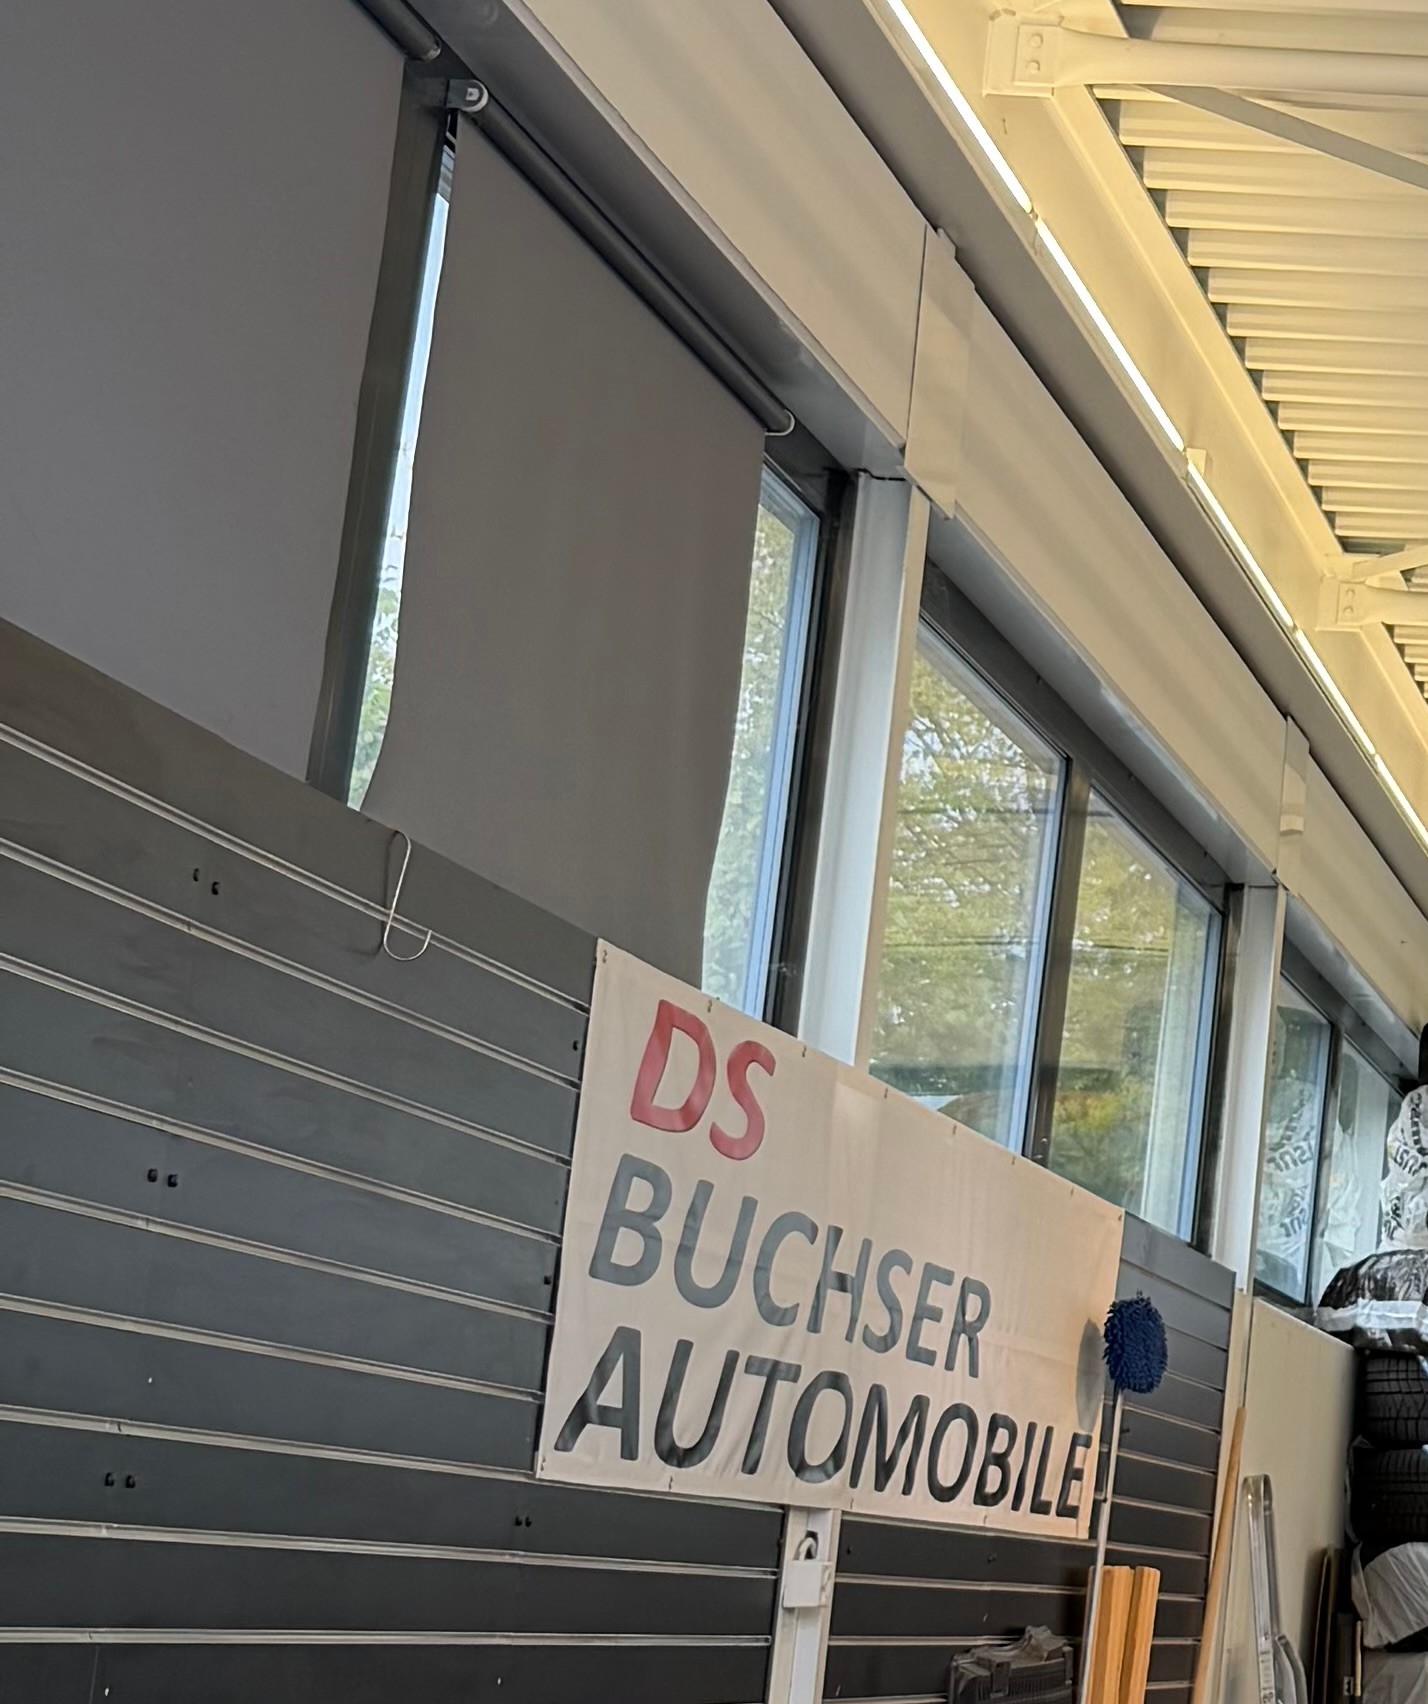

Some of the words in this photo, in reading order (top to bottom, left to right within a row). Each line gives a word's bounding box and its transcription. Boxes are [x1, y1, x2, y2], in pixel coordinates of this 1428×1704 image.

[630, 998, 775, 1161] DS
[588, 1153, 991, 1380] BUCHSER
[553, 1326, 1092, 1520] AUTOMOBILE
